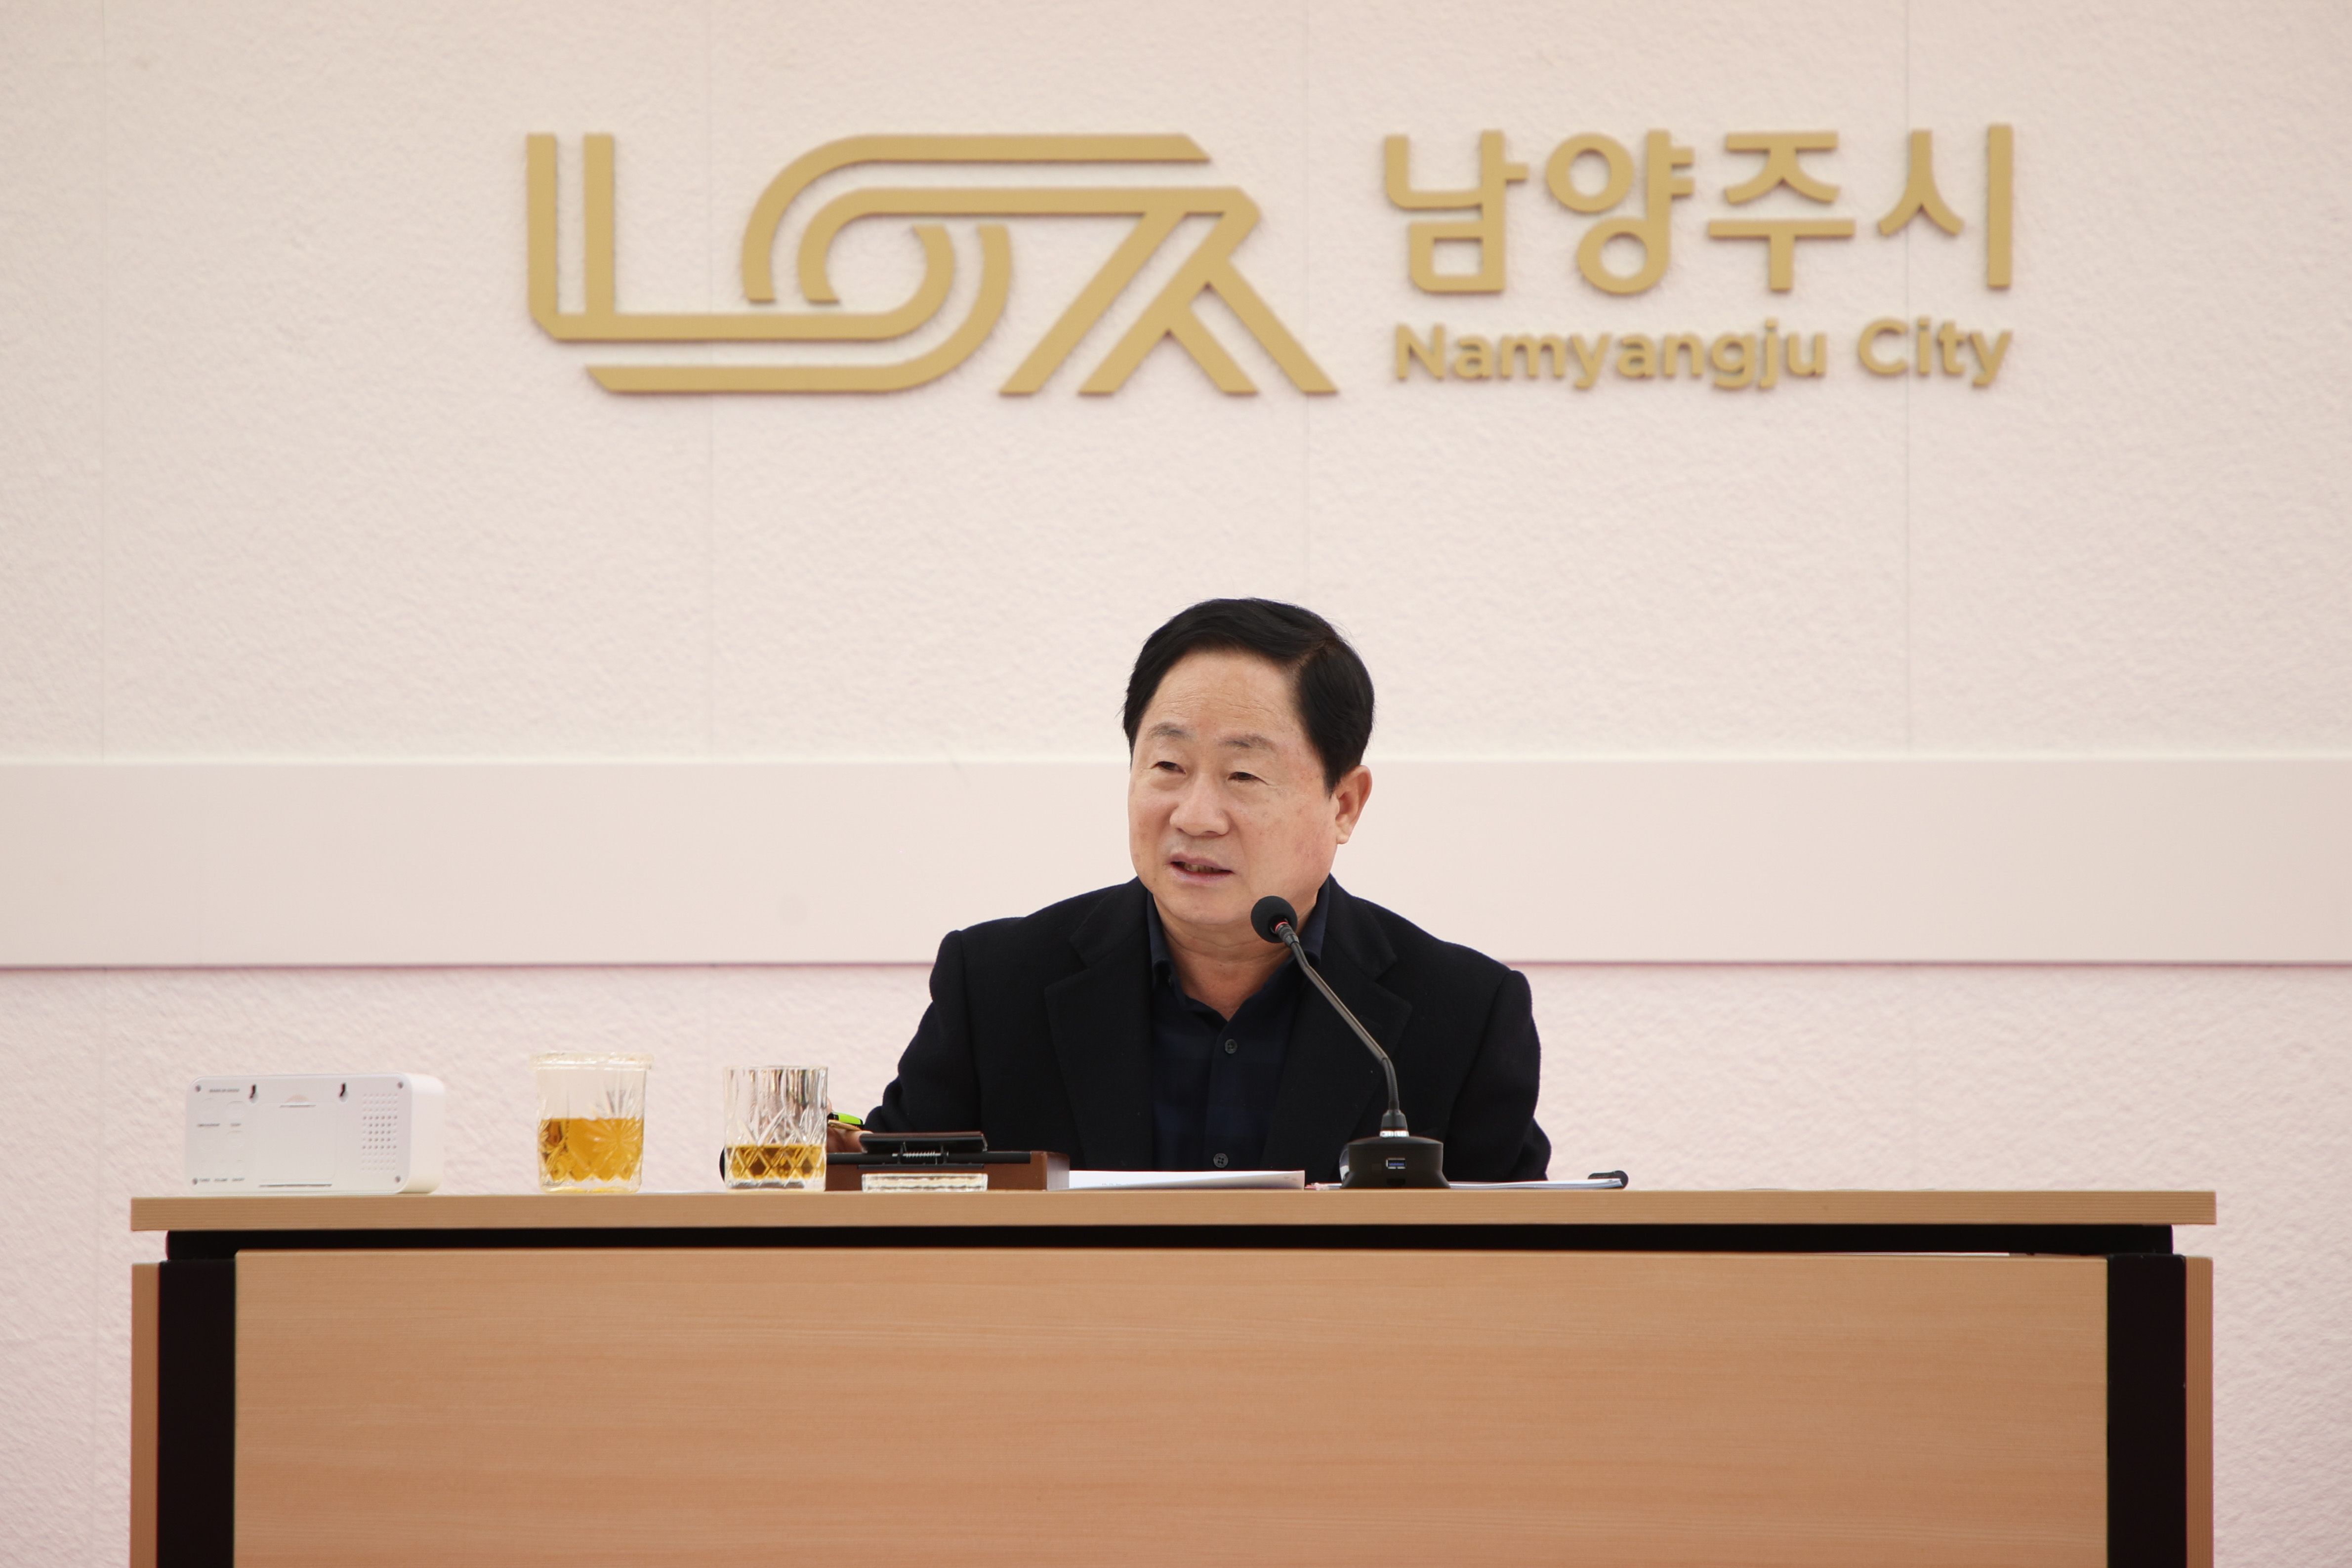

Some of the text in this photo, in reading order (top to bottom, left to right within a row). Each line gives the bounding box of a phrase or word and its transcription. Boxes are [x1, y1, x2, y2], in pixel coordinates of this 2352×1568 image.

[1384, 124, 2013, 295] 남양주시
[1395, 316, 2012, 390] Namyangju City
